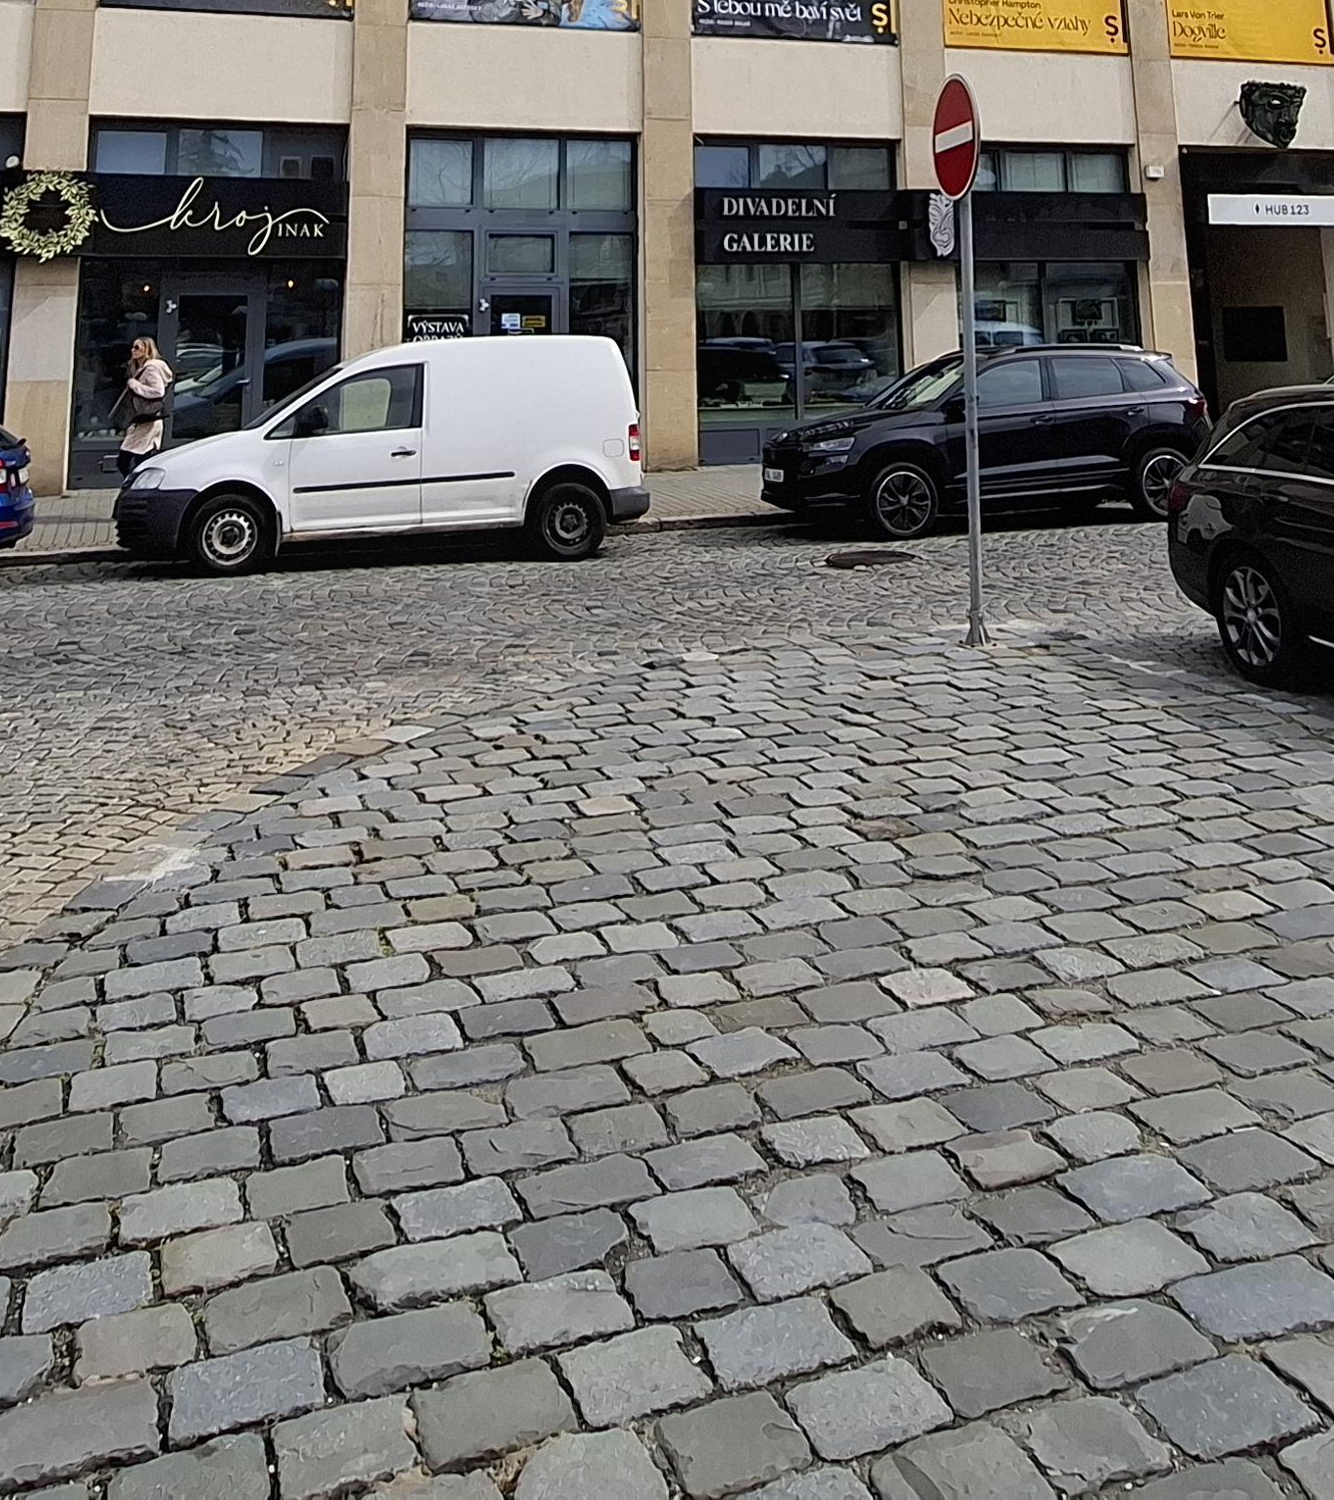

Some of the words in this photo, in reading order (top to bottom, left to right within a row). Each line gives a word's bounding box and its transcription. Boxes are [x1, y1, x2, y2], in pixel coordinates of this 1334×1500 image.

[795, 0, 828, 20] baví
[948, 7, 1044, 31] Nebezpečné
[1172, 9, 1188, 18] Lars
[1189, 10, 1206, 19] Von
[1206, 11, 1225, 20] Trier
[1173, 20, 1226, 42] Dogville
[722, 193, 837, 217] DIVADELNÍ
[1265, 204, 1288, 215] HUB
[1291, 204, 1310, 215] 123
[277, 223, 325, 238] INAK
[723, 232, 815, 252] GALERIE
[412, 319, 465, 334] VÝSTAVA
